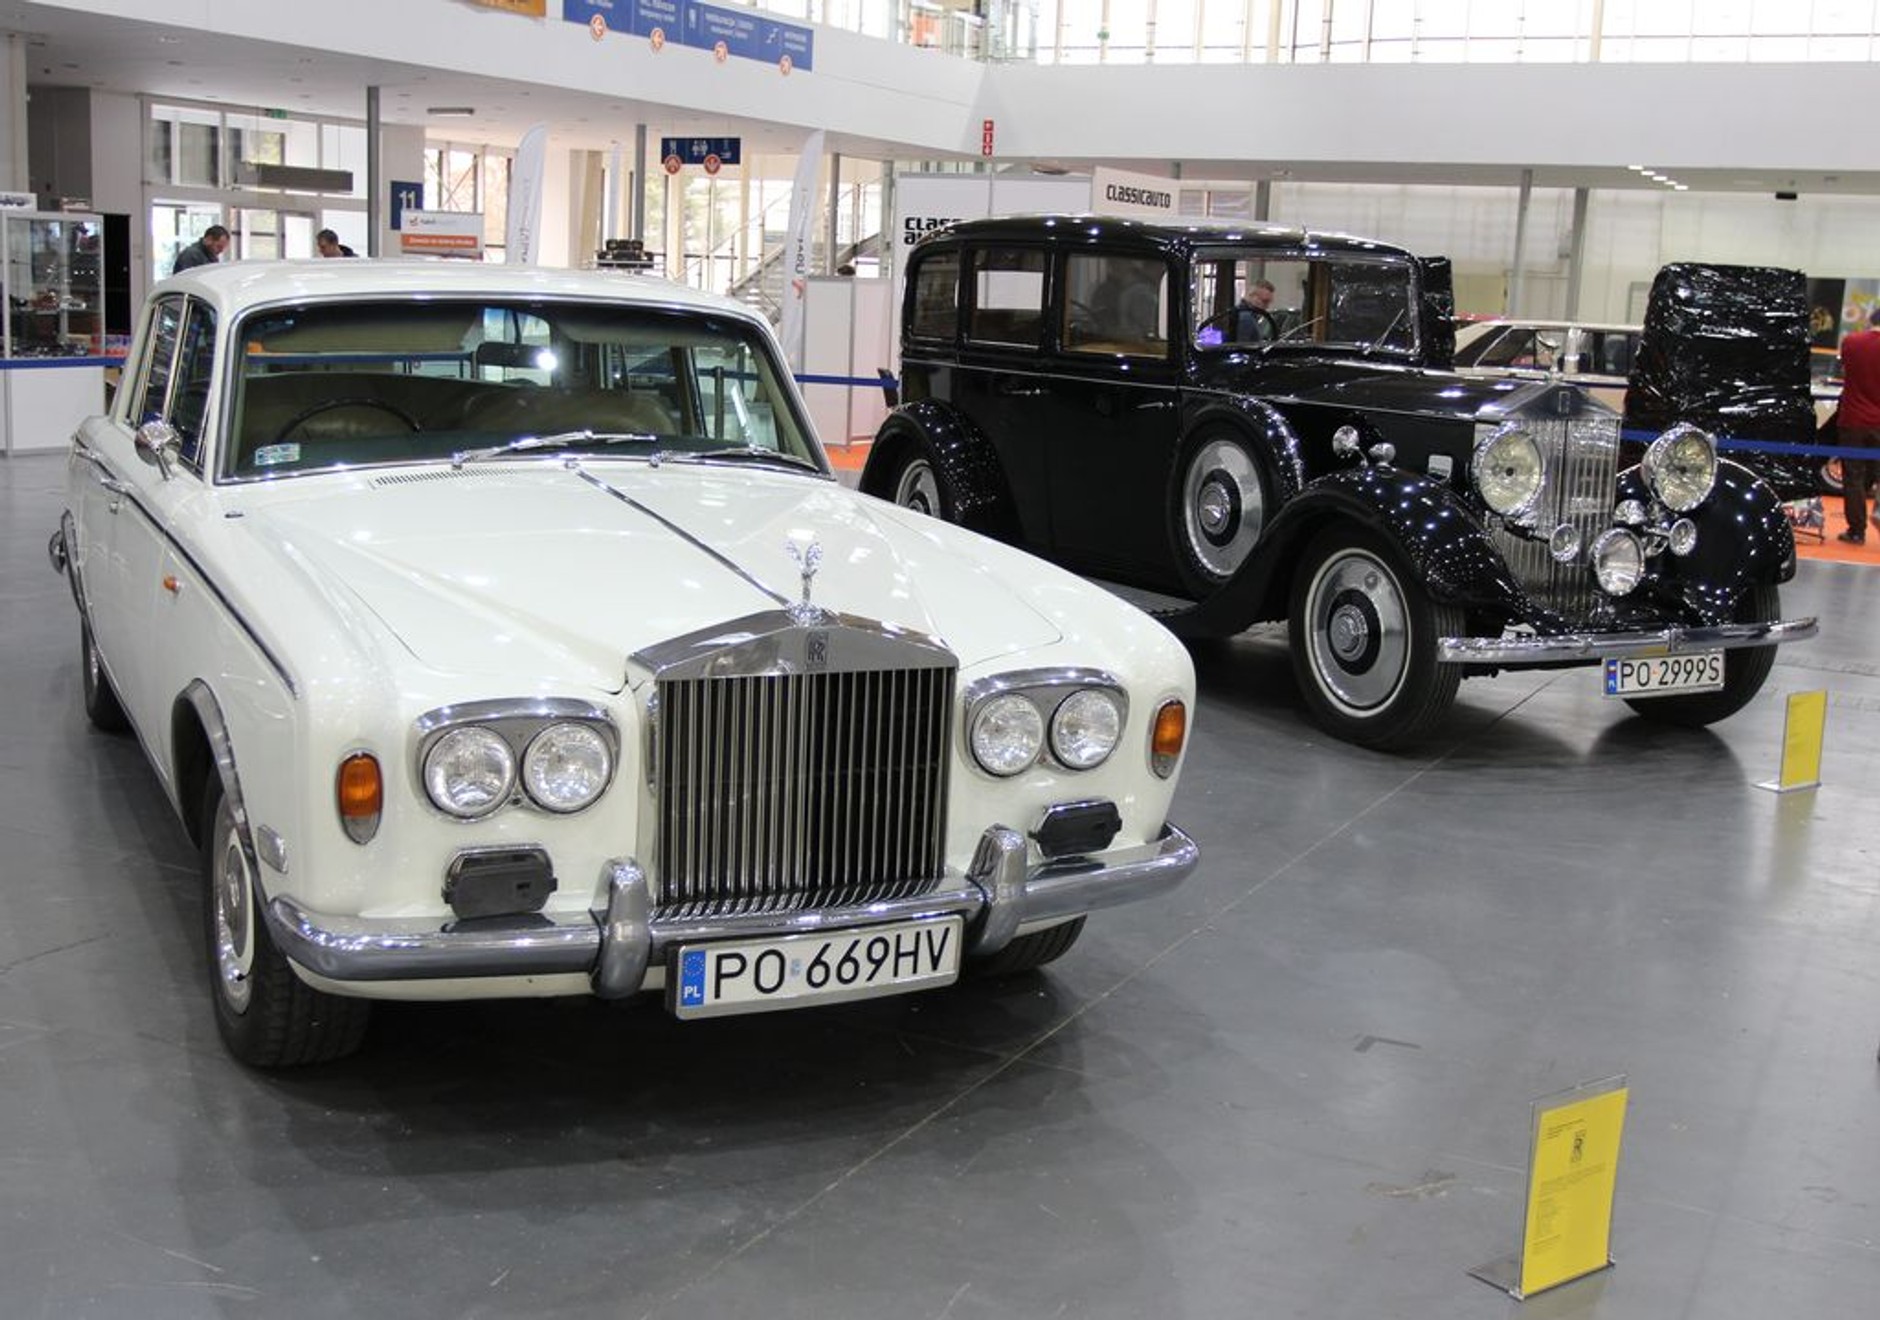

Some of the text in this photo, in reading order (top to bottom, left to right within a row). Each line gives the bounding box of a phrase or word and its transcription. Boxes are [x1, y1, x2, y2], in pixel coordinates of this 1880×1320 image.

[399, 190, 416, 210] 11
[1620, 657, 1720, 689] PO 2999S
[714, 926, 950, 1000] PO 669HV
[683, 985, 701, 999] PL
